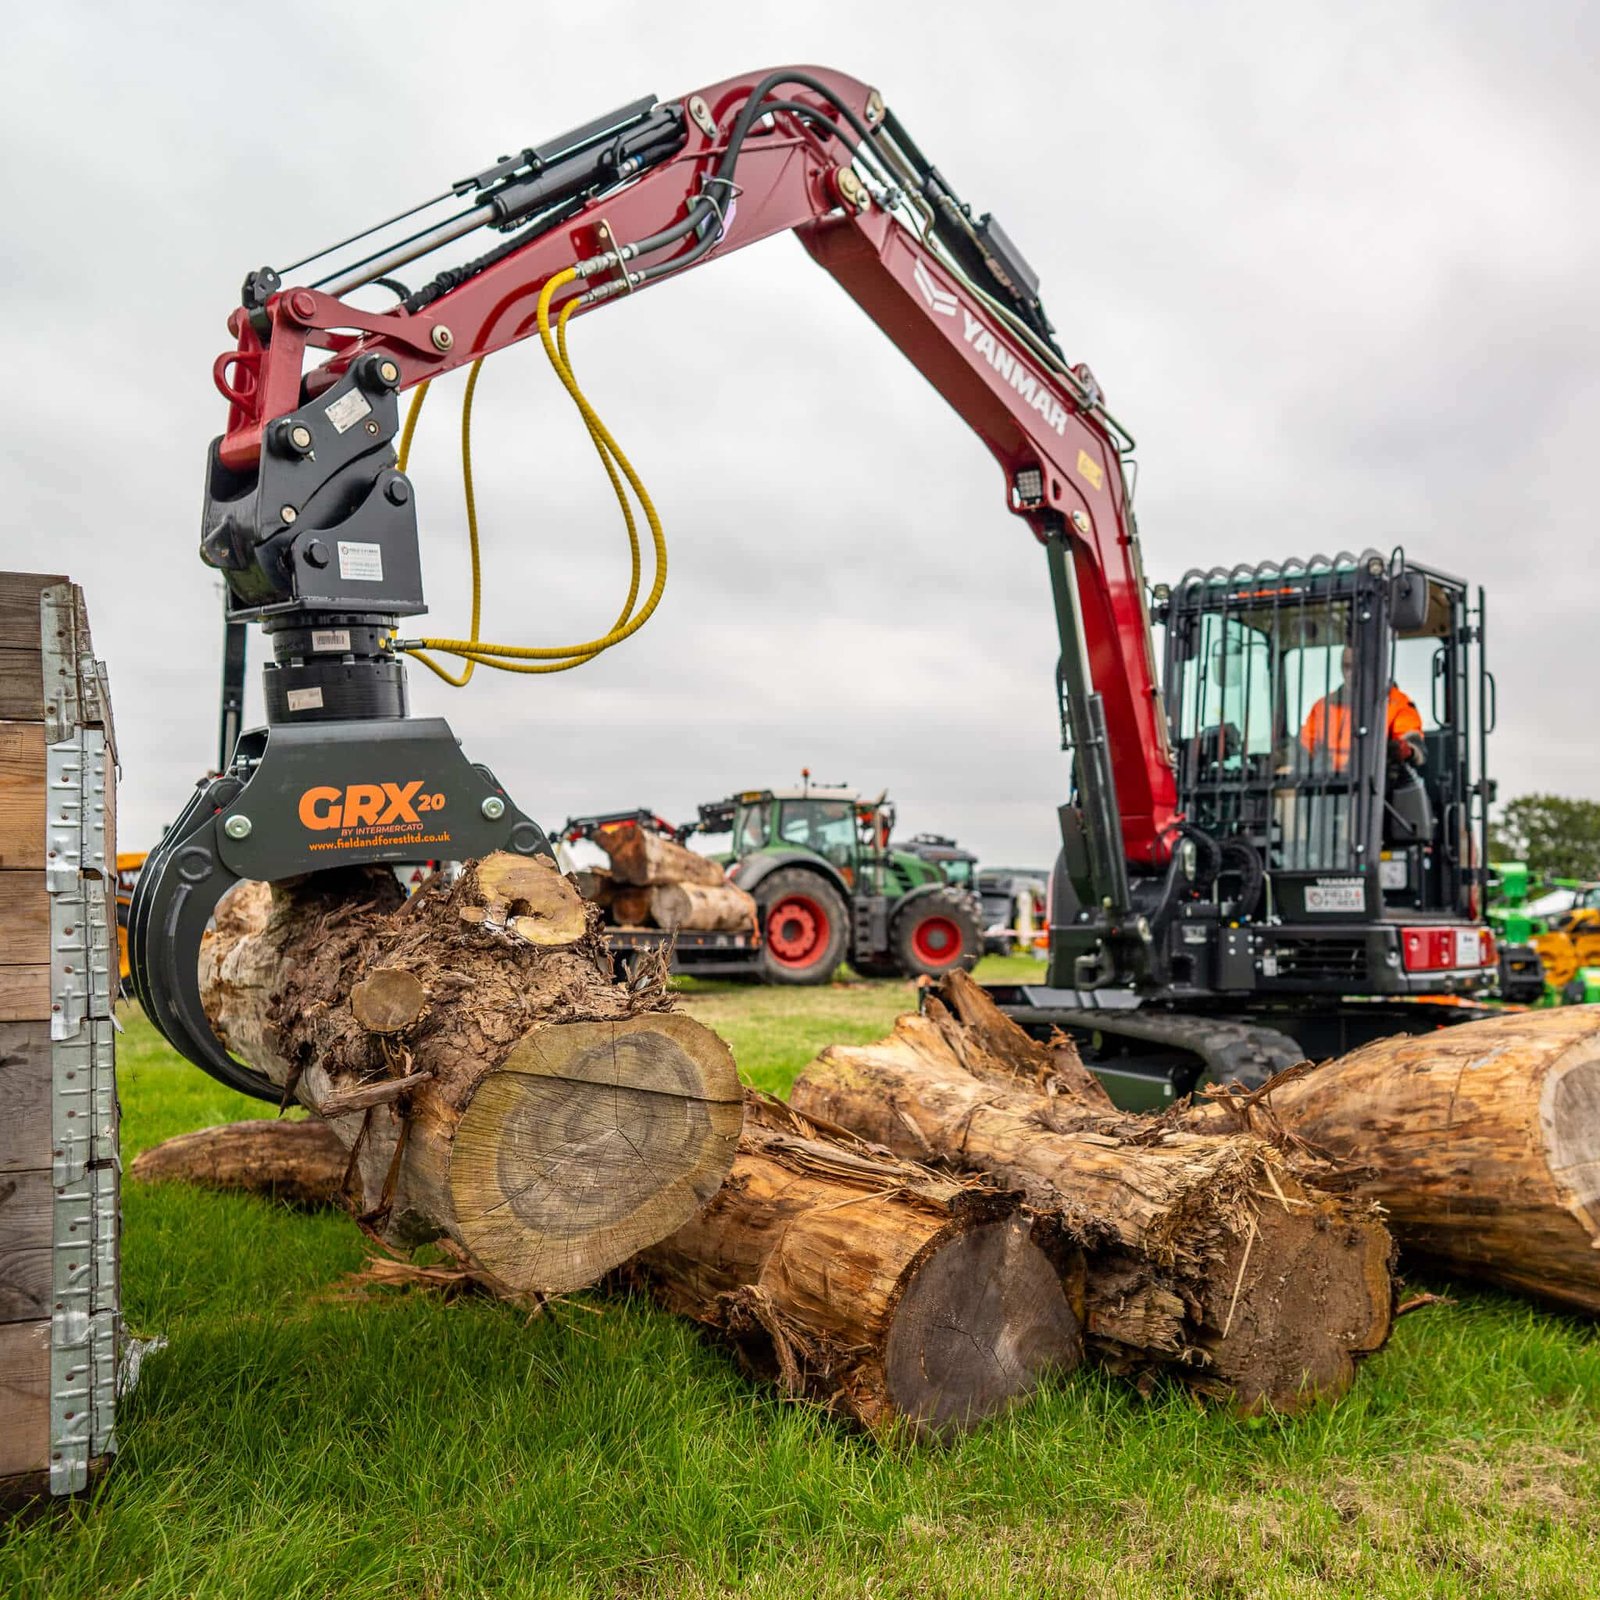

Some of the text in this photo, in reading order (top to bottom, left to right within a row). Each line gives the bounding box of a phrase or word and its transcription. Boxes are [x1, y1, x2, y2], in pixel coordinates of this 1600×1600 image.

[964, 308, 1068, 436] YANMAR
[298, 780, 446, 831] GRX 20
[309, 831, 451, 851] www.fieldandforestltd.co.uk
[341, 822, 424, 837] BY INTERMERCATO
